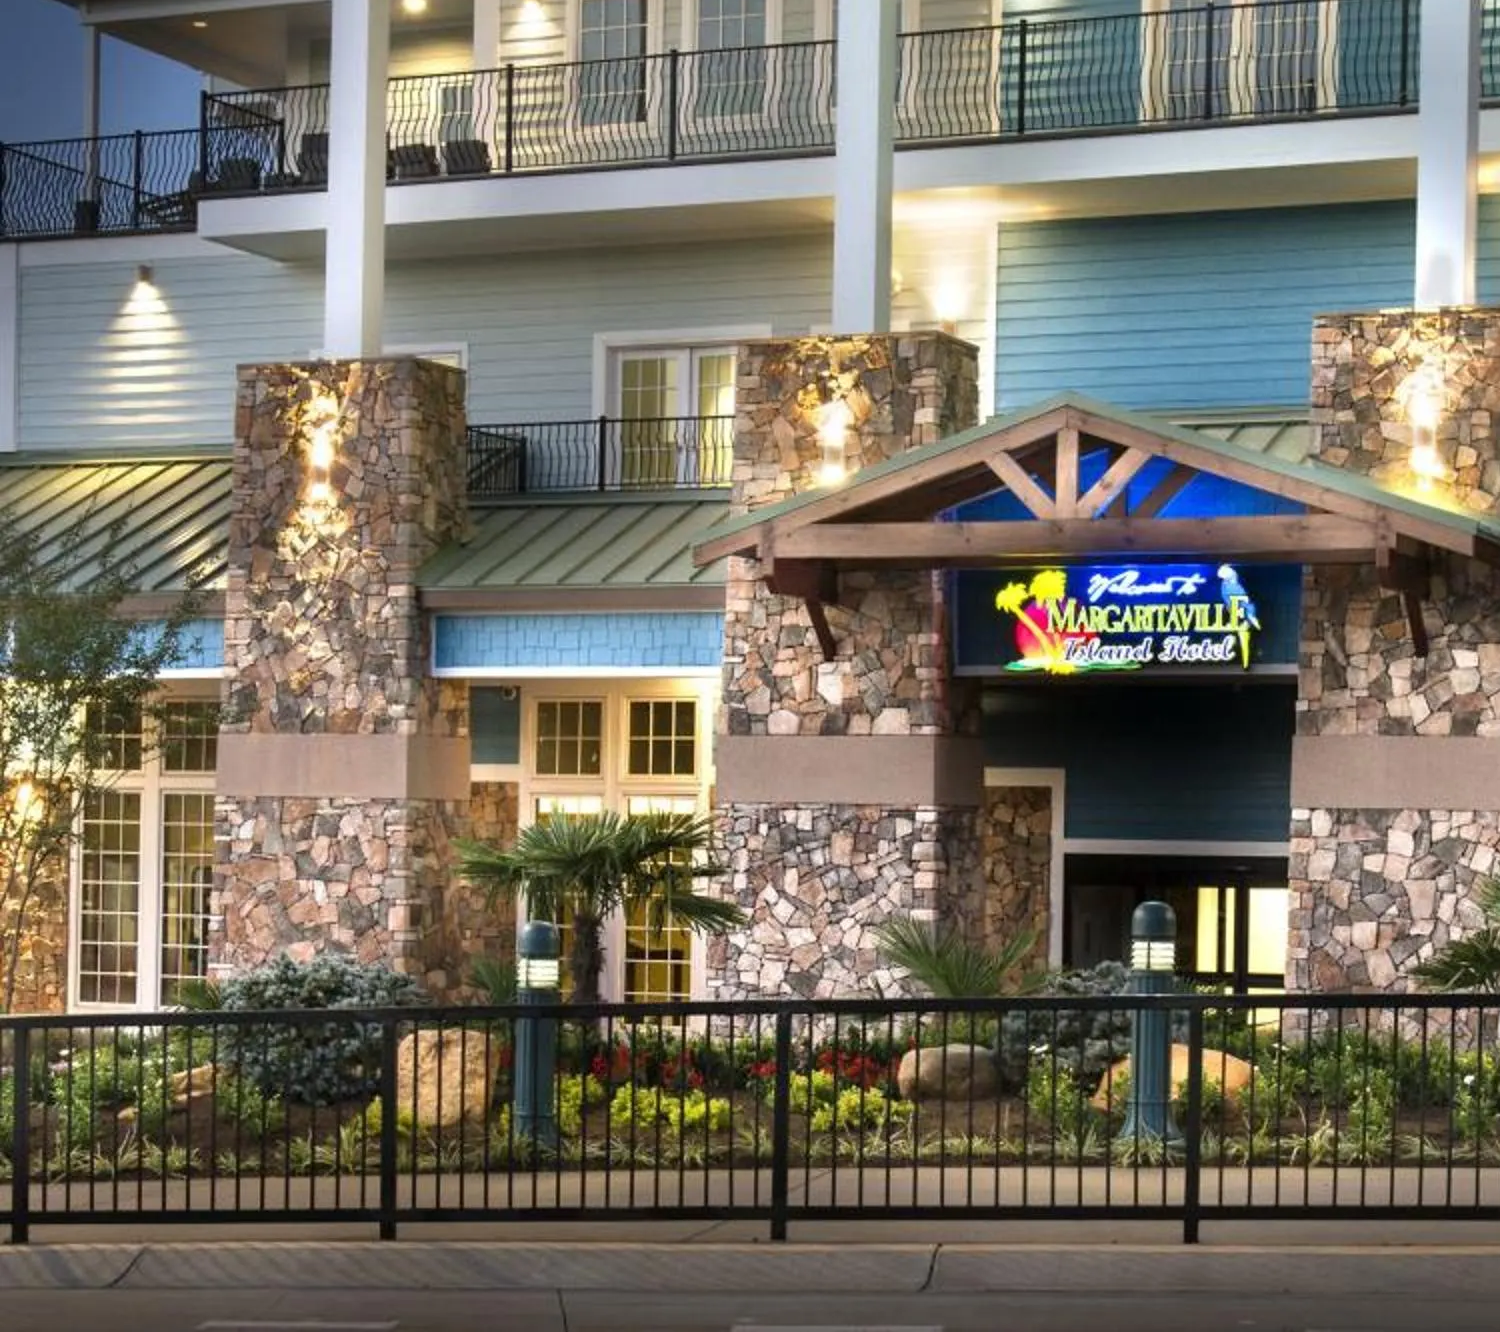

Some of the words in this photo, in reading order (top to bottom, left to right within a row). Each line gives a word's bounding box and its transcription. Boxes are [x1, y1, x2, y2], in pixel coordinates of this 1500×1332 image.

[1047, 596, 1248, 632] MARGARITAVILLE
[1065, 637, 1153, 662] Island
[1159, 636, 1236, 662] Hotel
